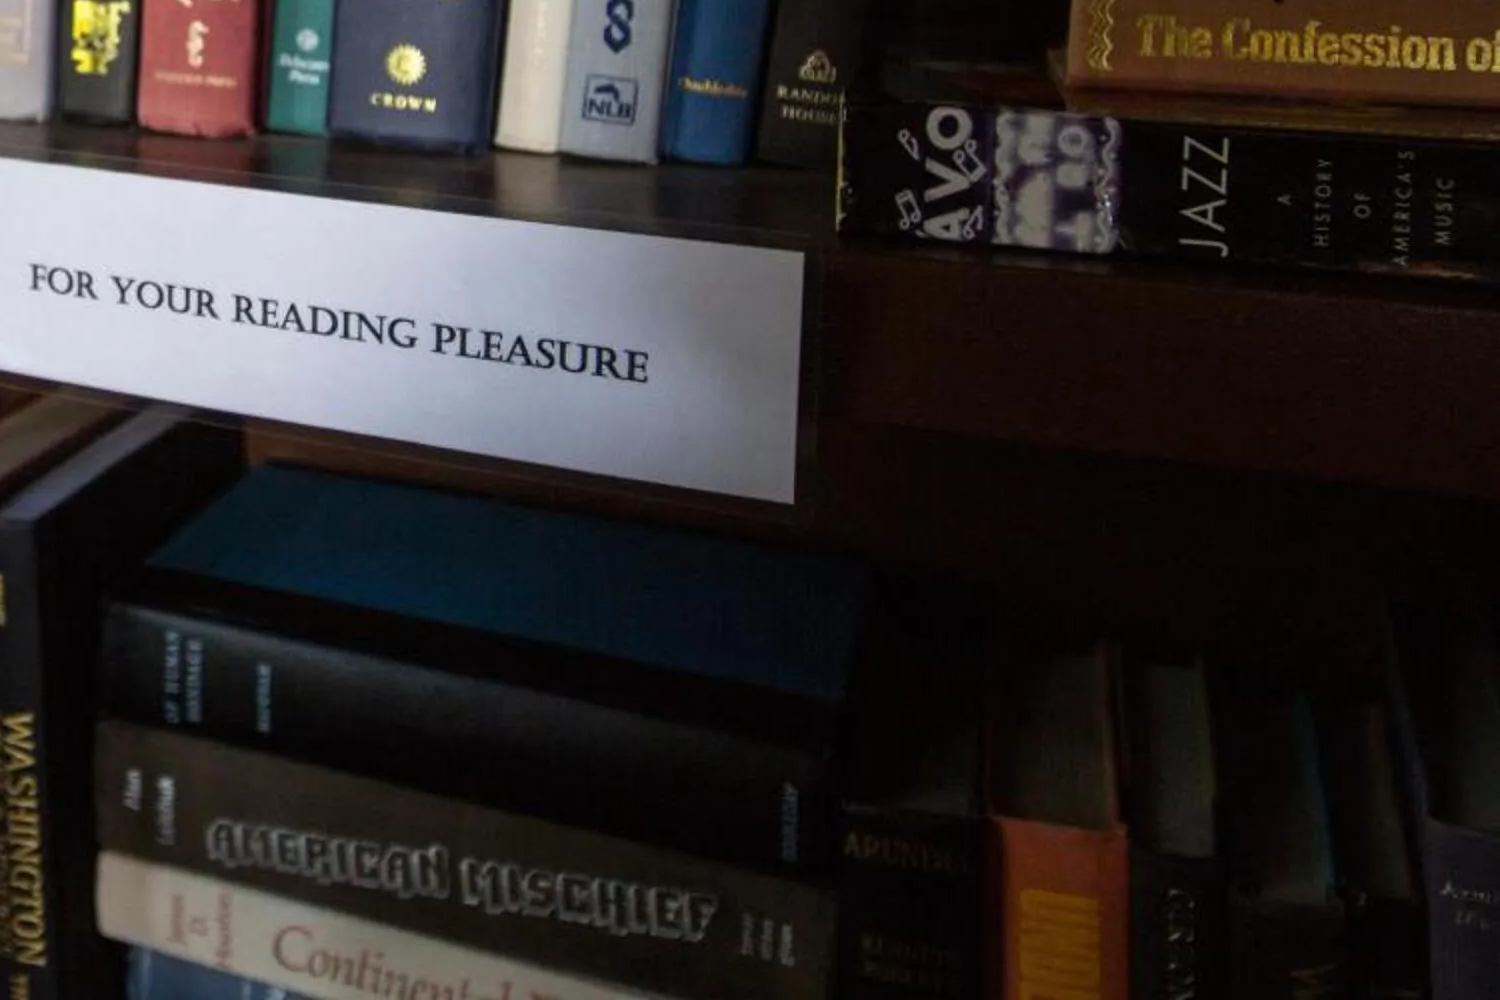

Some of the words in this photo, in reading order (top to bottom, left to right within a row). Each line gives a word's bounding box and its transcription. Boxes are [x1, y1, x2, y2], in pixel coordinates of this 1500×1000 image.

[1136, 13, 1213, 59] The
[1220, 10, 1457, 73] Confession
[369, 91, 438, 113] CROWN
[1179, 134, 1230, 260] JAZZ
[1311, 156, 1334, 249] HISTORY
[1351, 191, 1373, 220] OF
[1433, 176, 1457, 247] MUSIC
[27, 262, 99, 302] FOR
[109, 276, 221, 322] YOUR
[231, 294, 419, 351] READING
[430, 323, 651, 386] PLEASURE
[0, 711, 48, 968] WASHINGTON
[206, 817, 452, 900] AMERICAN
[459, 857, 720, 942] MISCHIEF
[271, 924, 514, 1000] Continentl
